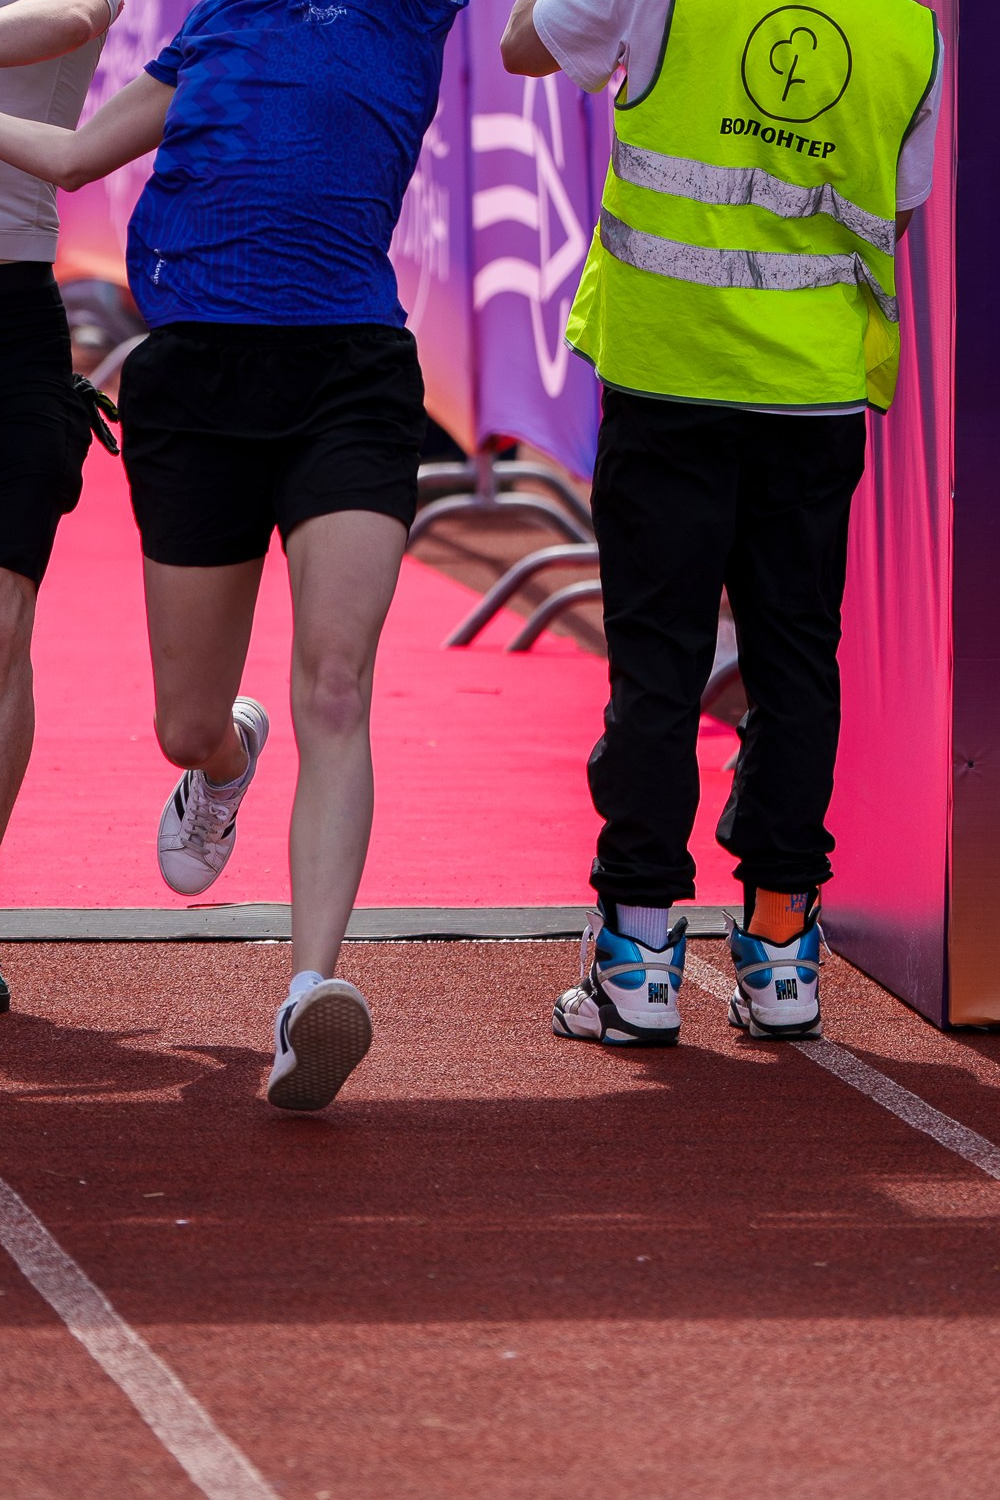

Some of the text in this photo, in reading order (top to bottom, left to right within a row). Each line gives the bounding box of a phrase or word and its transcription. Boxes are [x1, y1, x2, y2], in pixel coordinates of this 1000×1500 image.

[720, 118, 836, 158] ВОЛОНТЕР
[648, 983, 668, 1006] SHAQ
[775, 978, 798, 1000] SHAQ
